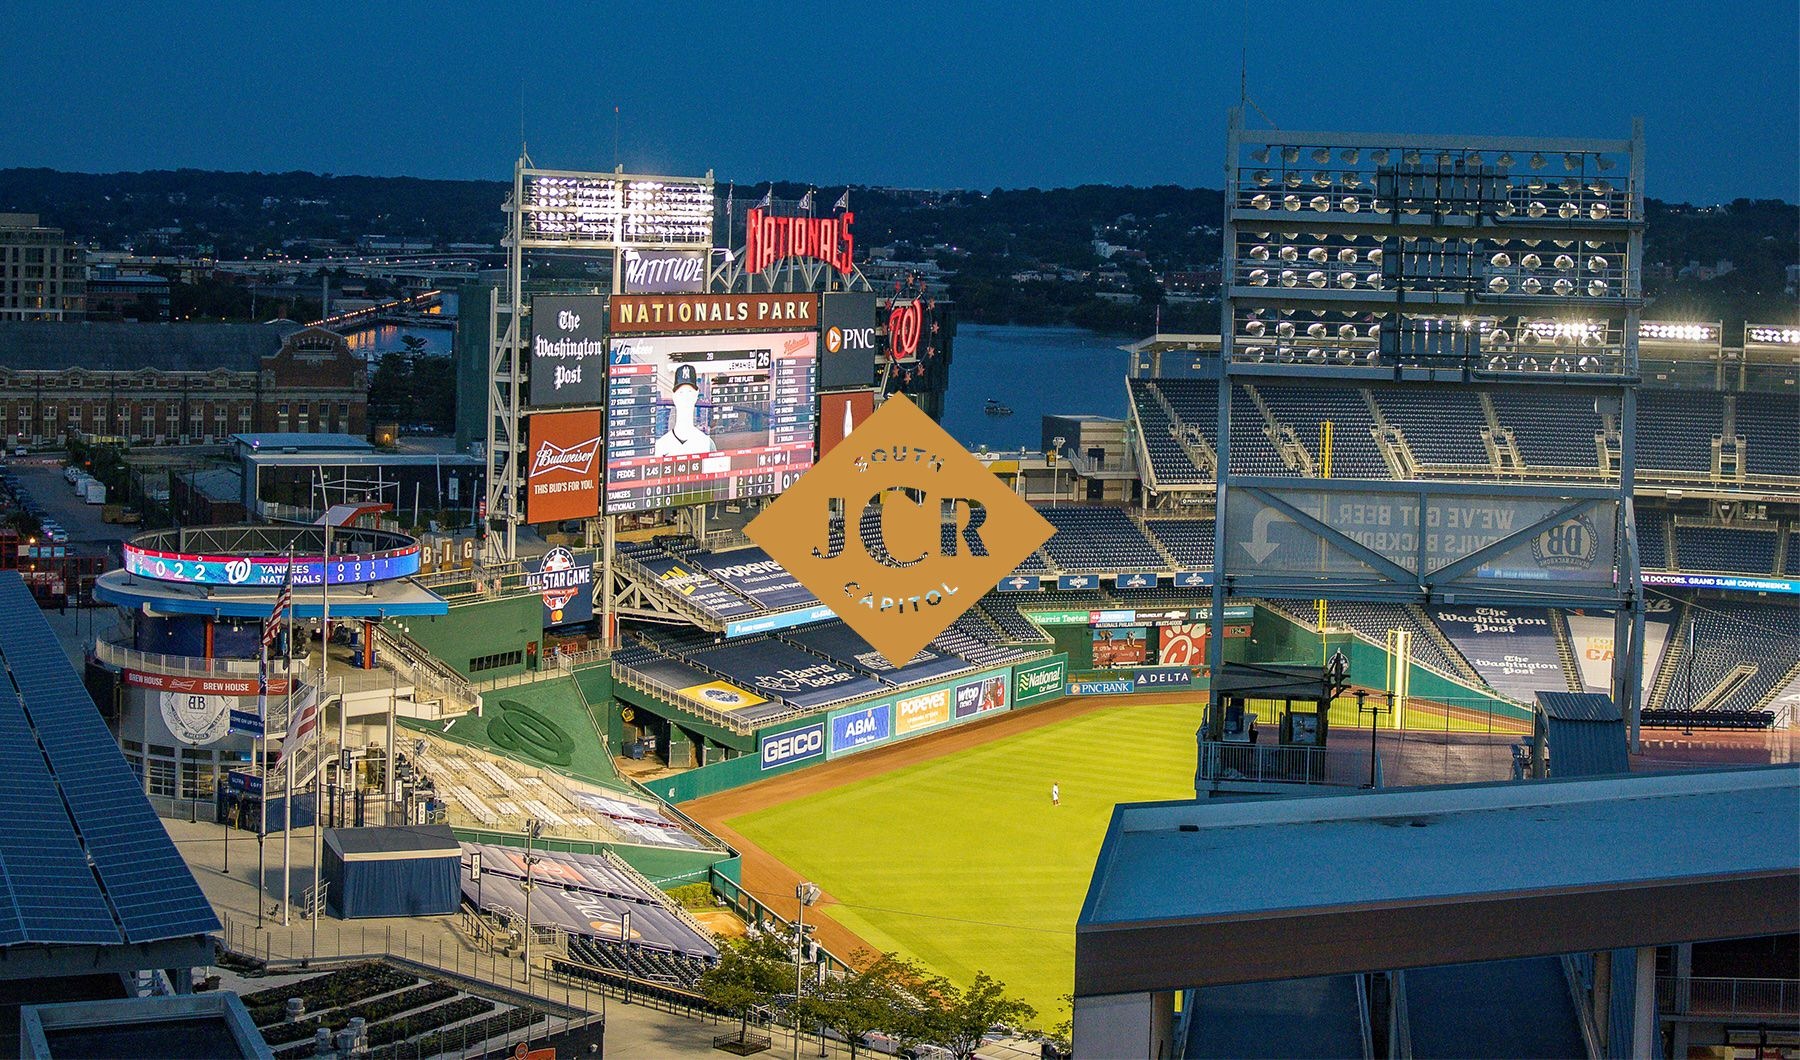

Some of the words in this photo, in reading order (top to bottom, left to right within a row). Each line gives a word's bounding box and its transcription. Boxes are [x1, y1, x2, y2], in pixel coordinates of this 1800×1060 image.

[746, 208, 854, 274] NATIONALS
[625, 255, 704, 285] NATITUDE
[620, 302, 748, 324] NATIONALS
[758, 301, 810, 320] PARK
[558, 310, 580, 332] The
[842, 328, 875, 350] PNC
[535, 334, 602, 361] Washington
[757, 352, 770, 367] 26
[554, 365, 582, 390] Post
[536, 448, 593, 467] Budweiser
[617, 469, 636, 479] FEDDE
[664, 466, 671, 474] 25
[678, 464, 686, 472] 40
[534, 484, 548, 495] THIS
[549, 482, 568, 493] BUD'S
[568, 481, 580, 492] FOR
[580, 480, 594, 490] YOU.
[608, 491, 631, 499] YANKEES
[656, 487, 660, 495] 0
[677, 484, 680, 492] 1
[758, 475, 763, 483] 0
[768, 474, 772, 482] 2
[783, 474, 790, 489] 0
[607, 502, 636, 512] NATIONALS
[646, 499, 651, 507] 0
[666, 497, 670, 505] 0
[768, 485, 772, 493] 2
[156, 561, 165, 577] 0
[174, 562, 183, 578] 2
[194, 564, 206, 580] 2
[338, 564, 344, 572] 0
[354, 563, 361, 571] 0
[385, 560, 388, 568] 1
[337, 573, 344, 582] 0
[355, 572, 360, 580] 3
[370, 571, 376, 579] 0
[542, 572, 565, 590] STAR
[567, 569, 590, 586] GAME
[1650, 575, 1687, 584] DOCTORS.
[1689, 577, 1715, 585] GRAND
[1737, 580, 1791, 590] CONVENIENCE.
[1035, 615, 1060, 623] Harris
[1062, 615, 1087, 623] Teeter
[1438, 612, 1547, 626] Washington
[1475, 607, 1508, 617] The
[1473, 623, 1516, 634] Post
[777, 664, 836, 679] Harris
[1476, 659, 1558, 670] Washington
[1503, 666, 1535, 675] Post
[128, 673, 143, 684] BREW
[144, 675, 163, 686] HOUSE
[203, 682, 223, 691] BREW
[224, 683, 249, 692] HOUSE
[1150, 672, 1189, 683] DELTA
[957, 686, 979, 701] wtop
[1082, 683, 1103, 693] PNC
[1103, 682, 1129, 692] BANK
[959, 700, 972, 708] news
[764, 730, 822, 763] GEICO
